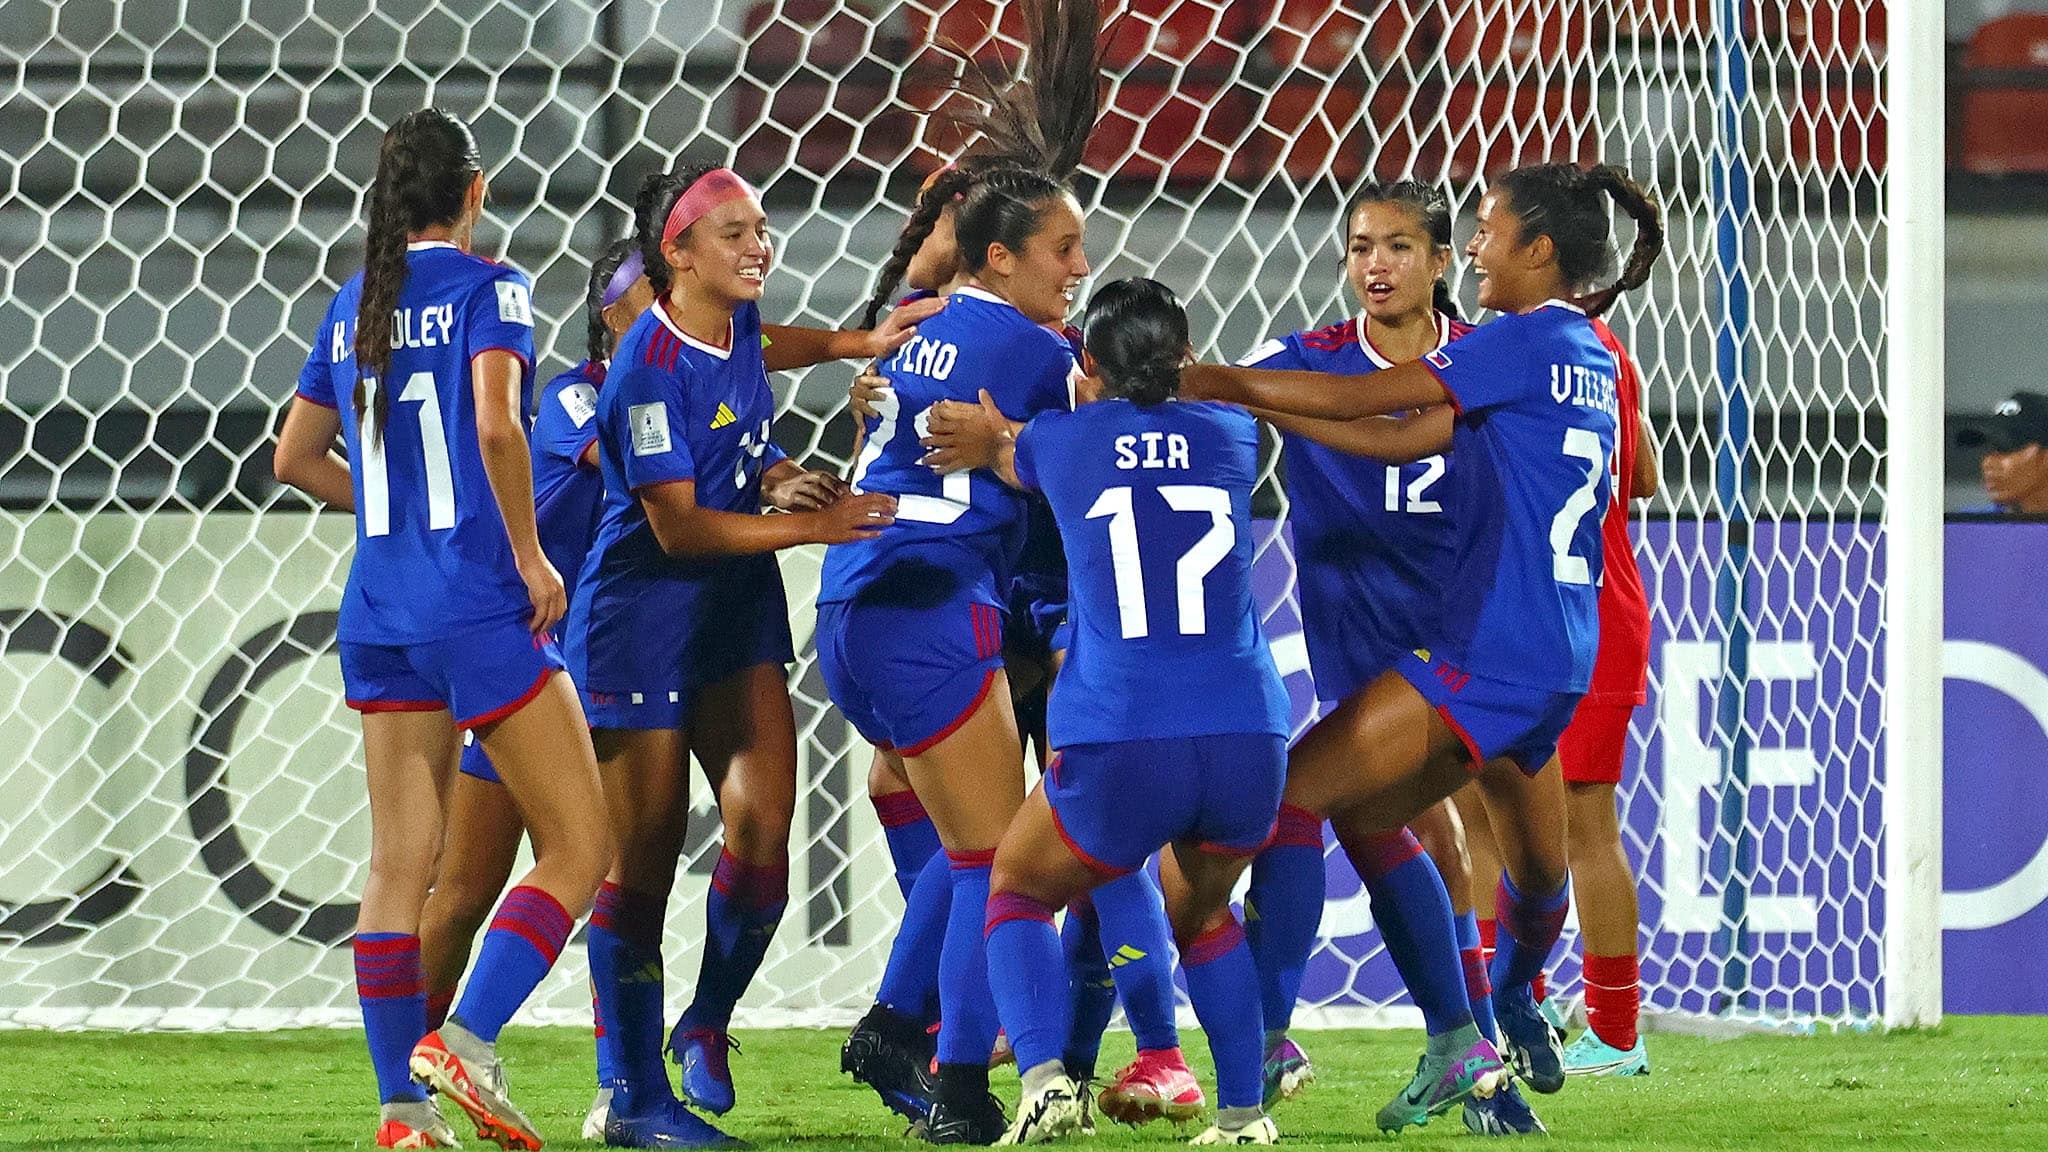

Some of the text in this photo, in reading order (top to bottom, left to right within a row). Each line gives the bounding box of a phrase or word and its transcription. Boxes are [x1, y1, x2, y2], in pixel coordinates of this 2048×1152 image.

[352, 371, 456, 538] 11
[1114, 431, 1190, 470] SIR
[1385, 454, 1446, 513] 12
[1084, 485, 1236, 640] 17
